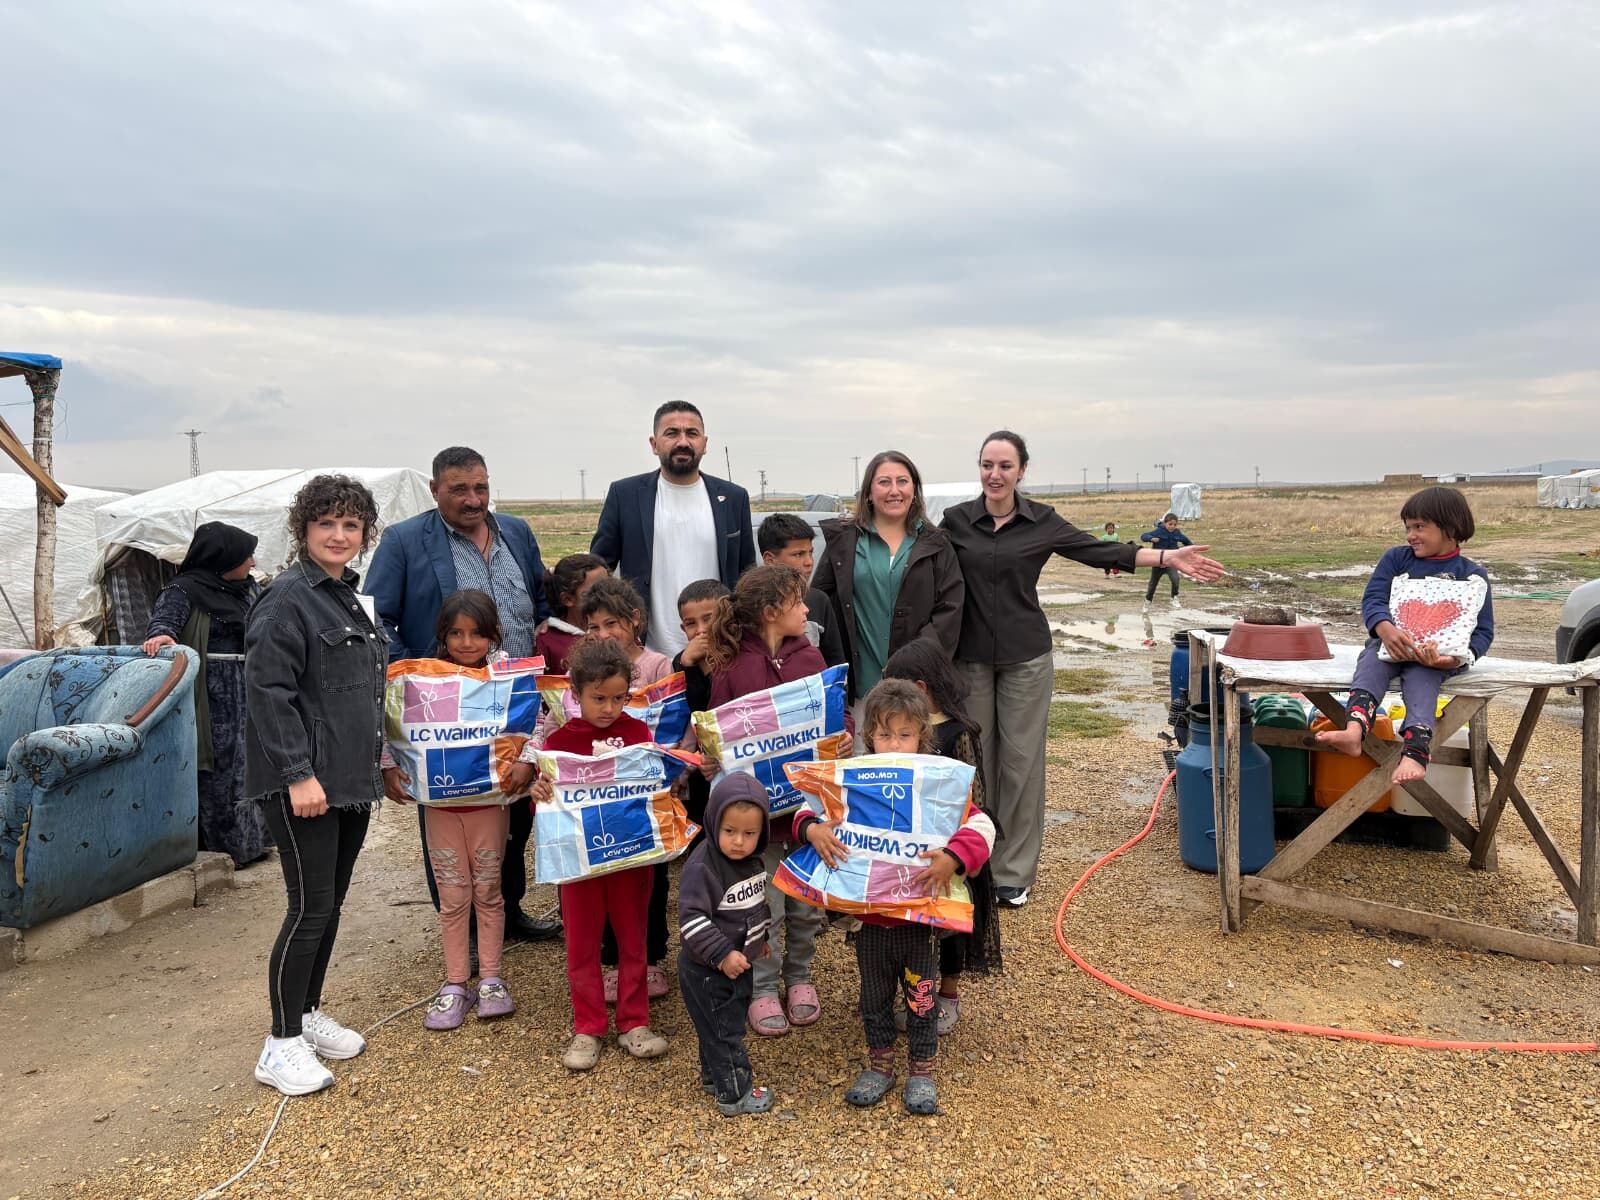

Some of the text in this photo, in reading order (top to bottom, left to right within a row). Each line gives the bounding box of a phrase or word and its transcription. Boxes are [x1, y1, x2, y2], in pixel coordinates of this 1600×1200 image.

[410, 728, 431, 742] LC
[733, 742, 756, 760] LC
[563, 789, 586, 804] LC
[904, 842, 929, 858] LC
